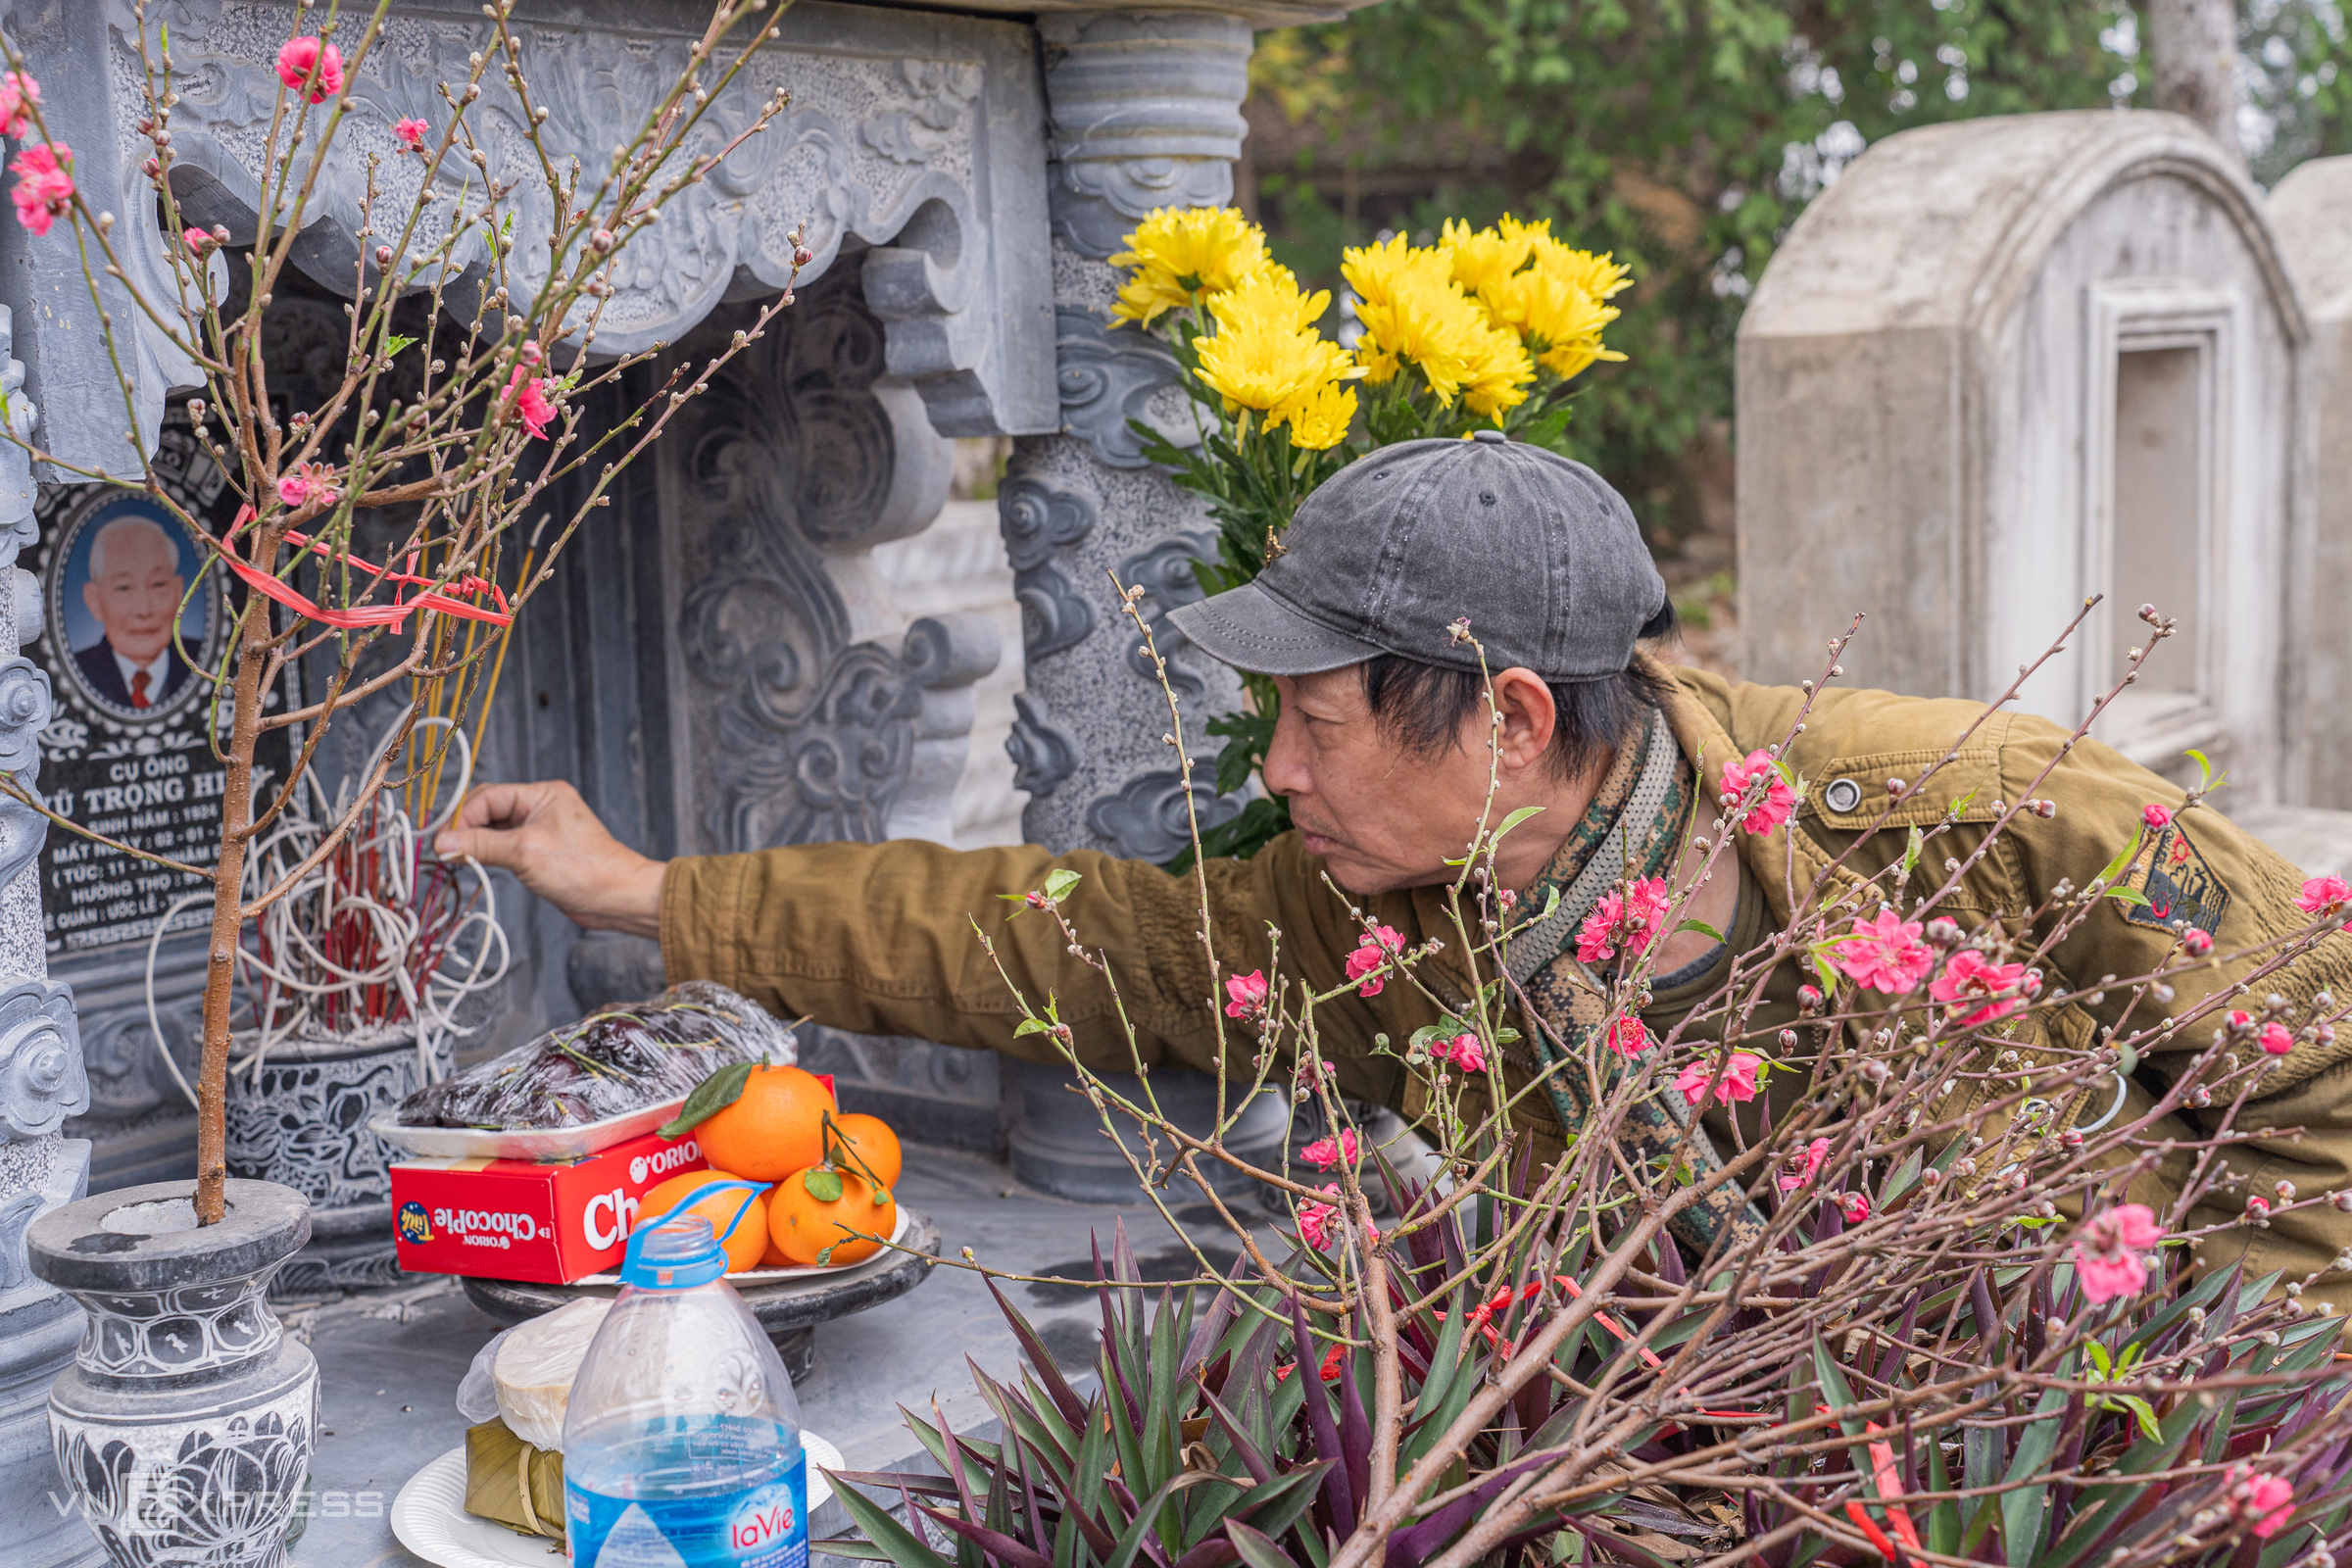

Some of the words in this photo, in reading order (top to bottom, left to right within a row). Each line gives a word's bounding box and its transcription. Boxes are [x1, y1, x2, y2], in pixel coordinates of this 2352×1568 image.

[110, 760, 140, 782] CỤ
[143, 754, 190, 778] ÔNG
[82, 776, 186, 812] TRỌNG
[87, 816, 128, 835] SINH
[52, 841, 91, 864] MẤT
[108, 859, 125, 877] 11
[137, 874, 172, 894] THỌ
[434, 1207, 536, 1242] ChocoPie
[464, 1234, 498, 1248] ORION
[732, 1504, 793, 1550] laVie
